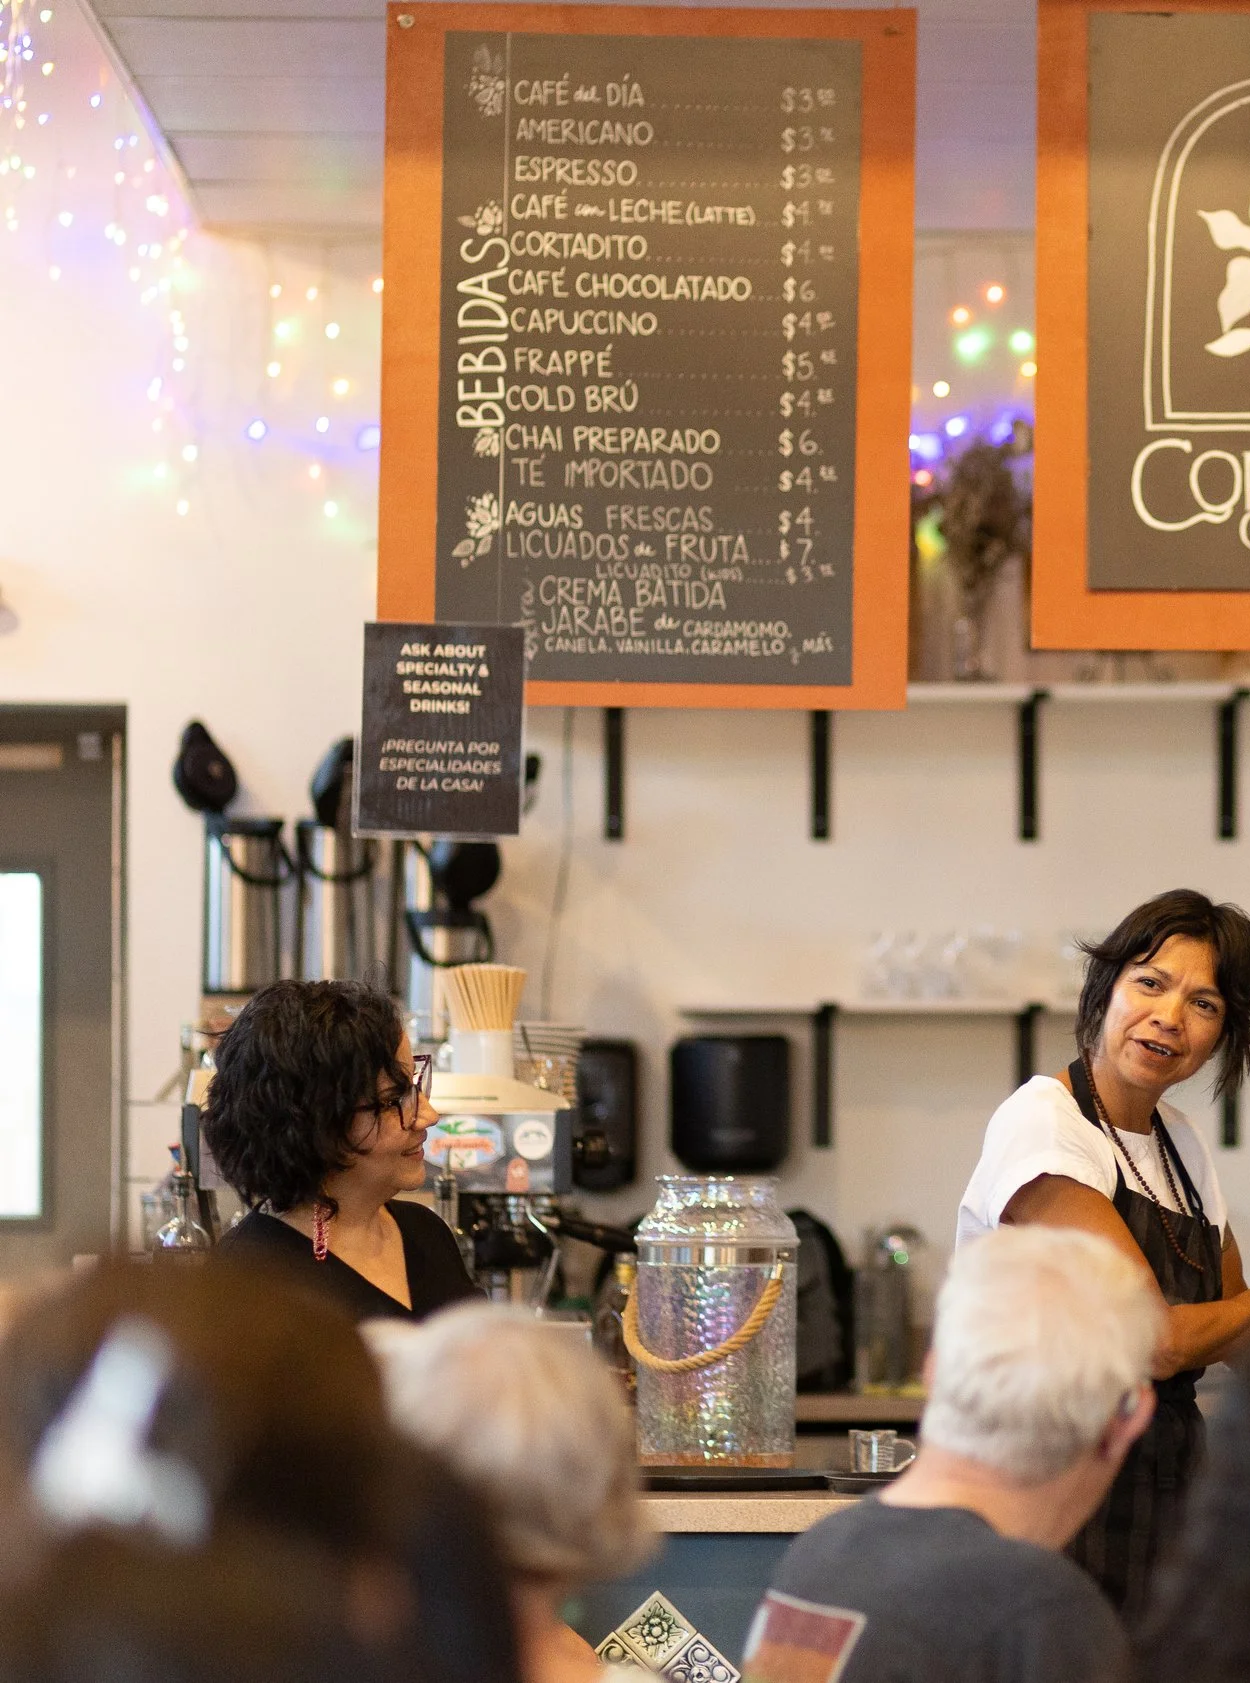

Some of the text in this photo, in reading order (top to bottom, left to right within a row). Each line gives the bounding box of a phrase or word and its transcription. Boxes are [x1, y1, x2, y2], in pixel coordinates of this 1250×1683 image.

[513, 72, 570, 106] CAFÉ
[573, 84, 602, 103] del
[605, 73, 645, 107] DÍA
[516, 117, 654, 146] AMERICANO
[514, 155, 638, 187] ESPRESSO
[510, 188, 569, 220] CAFÉ
[608, 198, 684, 225] LECHE
[685, 200, 757, 227] (LATTE)
[510, 230, 648, 261] CORTADITO
[508, 266, 570, 298] CAFÉ
[575, 272, 753, 302] CHOCOLATADO
[456, 237, 511, 428] BEBIDAS
[510, 307, 658, 336] CAPUCCINO
[513, 343, 614, 379] FRAPPÉ
[505, 384, 576, 412] COLD
[584, 378, 639, 414] BRÚ
[505, 423, 563, 452] CHAI
[573, 426, 721, 455] PREPARADO
[511, 453, 546, 488] TÉ
[565, 458, 713, 491] IMPORTADO
[505, 500, 584, 529] AGUAS
[605, 504, 714, 532] FRESCAS
[506, 528, 630, 561] LICUADOS
[634, 541, 657, 558] de
[665, 533, 750, 564] FRUTA
[595, 562, 692, 580] LICUADITO
[539, 575, 727, 610] CREMA BATIDA
[541, 606, 647, 638] JARABE
[654, 612, 680, 631] de
[400, 642, 487, 659] ASK ABOUT
[690, 638, 786, 658] CARAMELO
[802, 631, 835, 654] MÁS
[396, 661, 490, 678] SPECIALTY &
[403, 680, 482, 697] SEASONAL
[409, 699, 470, 715] DRINKS!
[381, 738, 500, 757] ¡PREGUNTA POR
[379, 756, 502, 775] ESPECIALIDADES
[396, 776, 484, 793] DE LA CASA!
